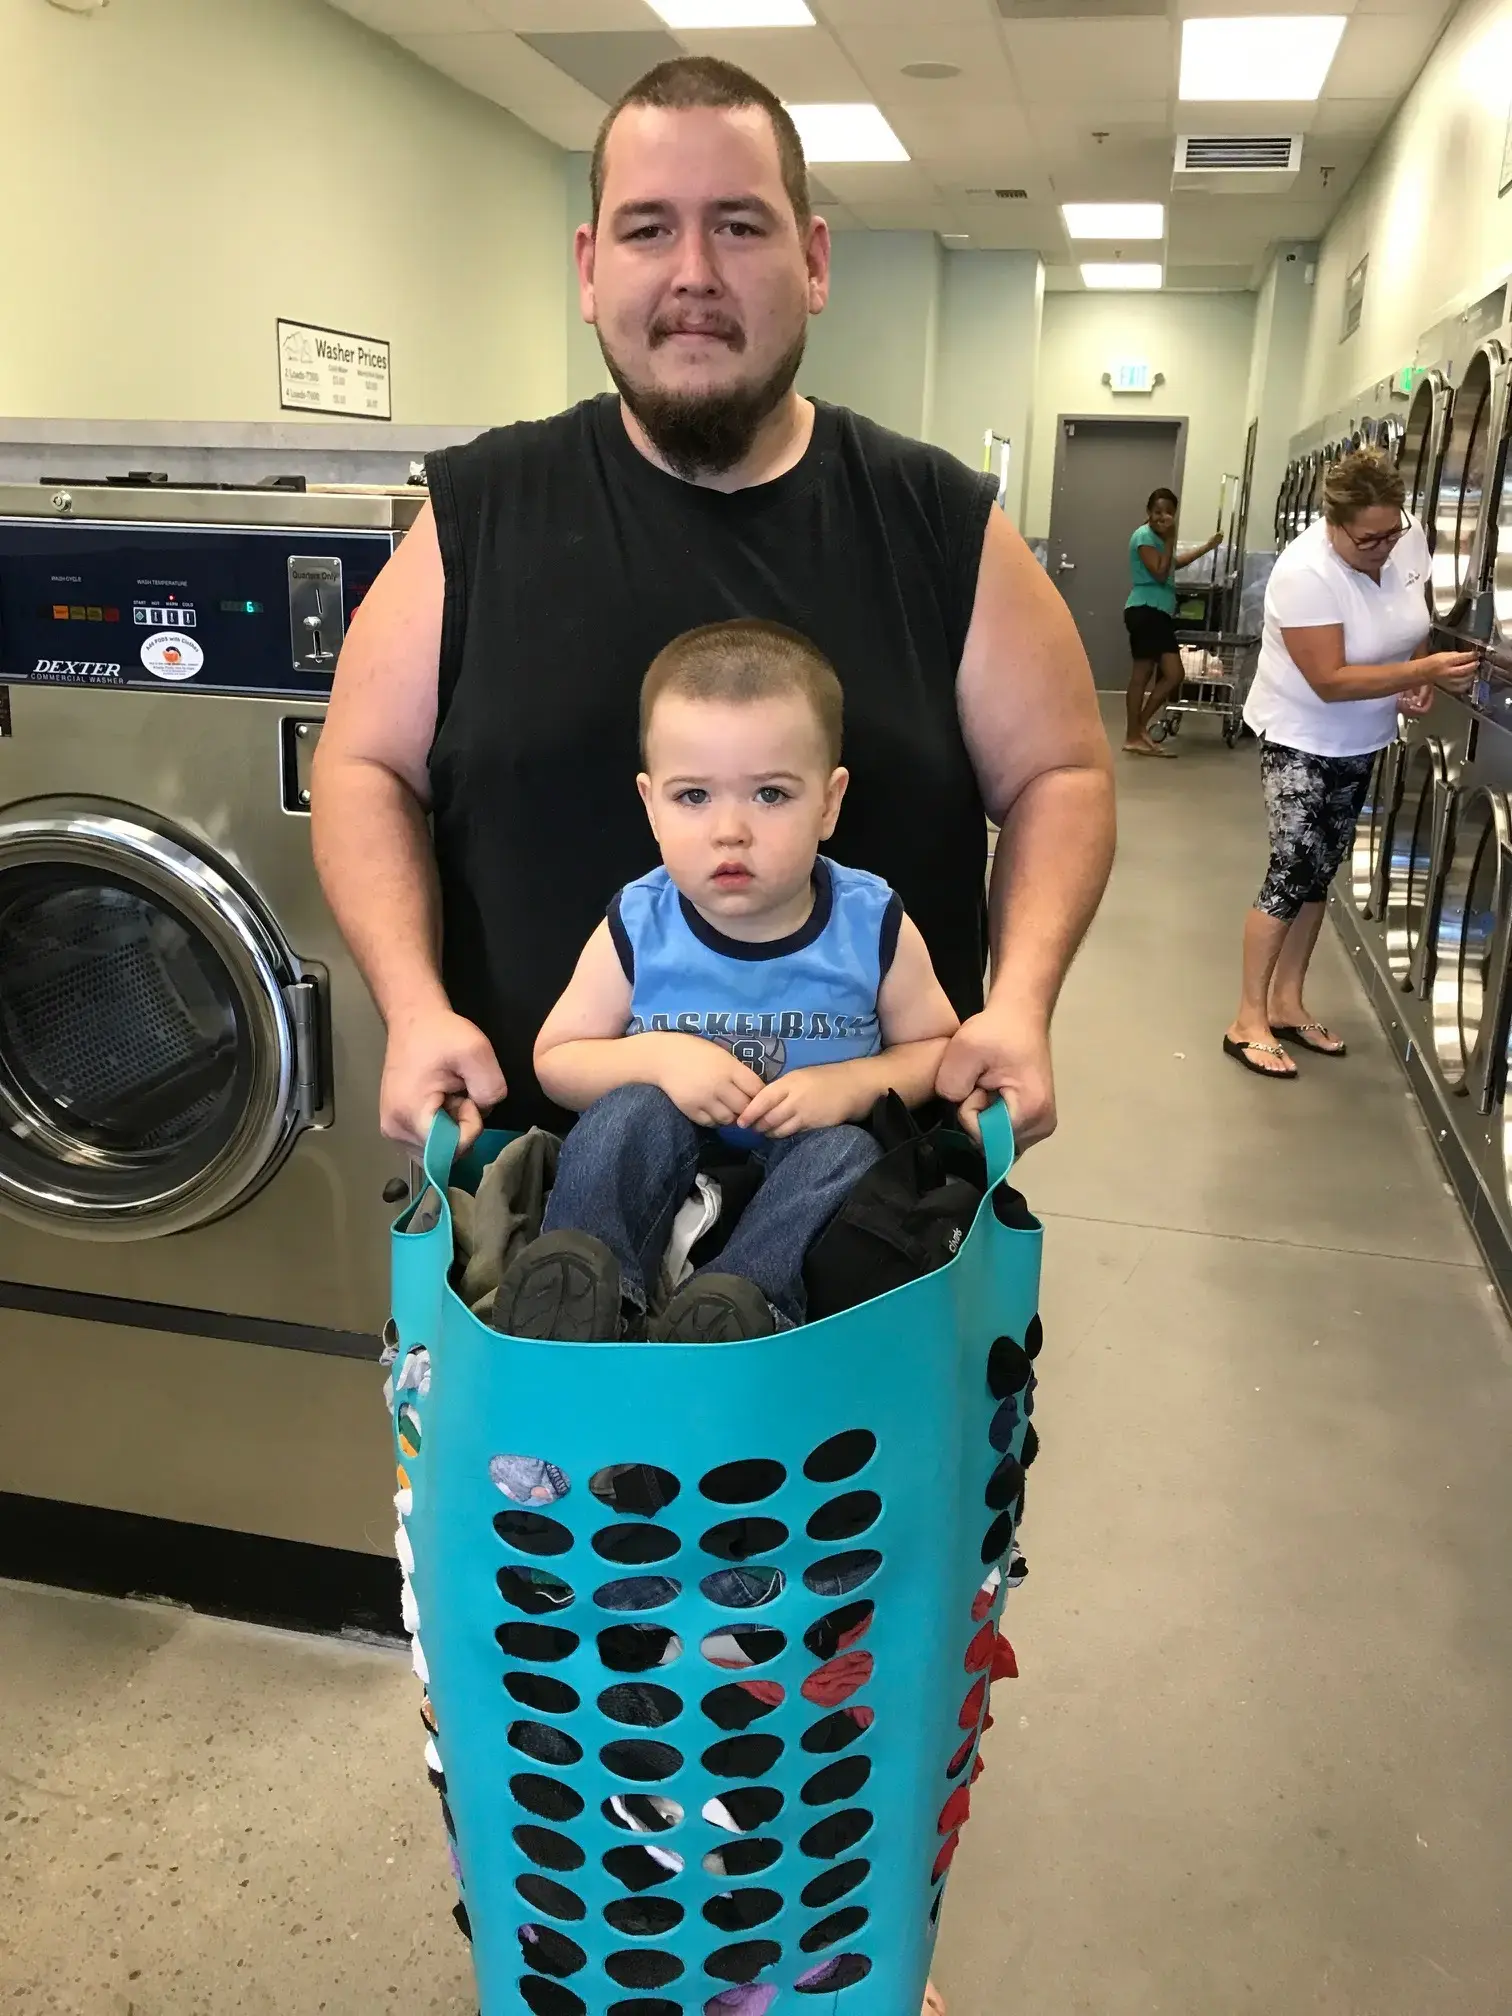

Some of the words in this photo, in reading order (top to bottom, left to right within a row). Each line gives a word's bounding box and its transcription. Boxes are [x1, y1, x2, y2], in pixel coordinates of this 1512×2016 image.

[315, 338, 354, 363] Washer
[358, 347, 387, 369] Prices
[292, 571, 320, 579] Quarters
[321, 571, 337, 582] Only
[152, 579, 188, 587] TEMPERATURE
[246, 601, 254, 613] 6
[33, 659, 121, 677] DEXTER
[30, 673, 86, 683] COMMERCIAL
[89, 676, 124, 685] WASHER
[732, 1039, 765, 1077] 8
